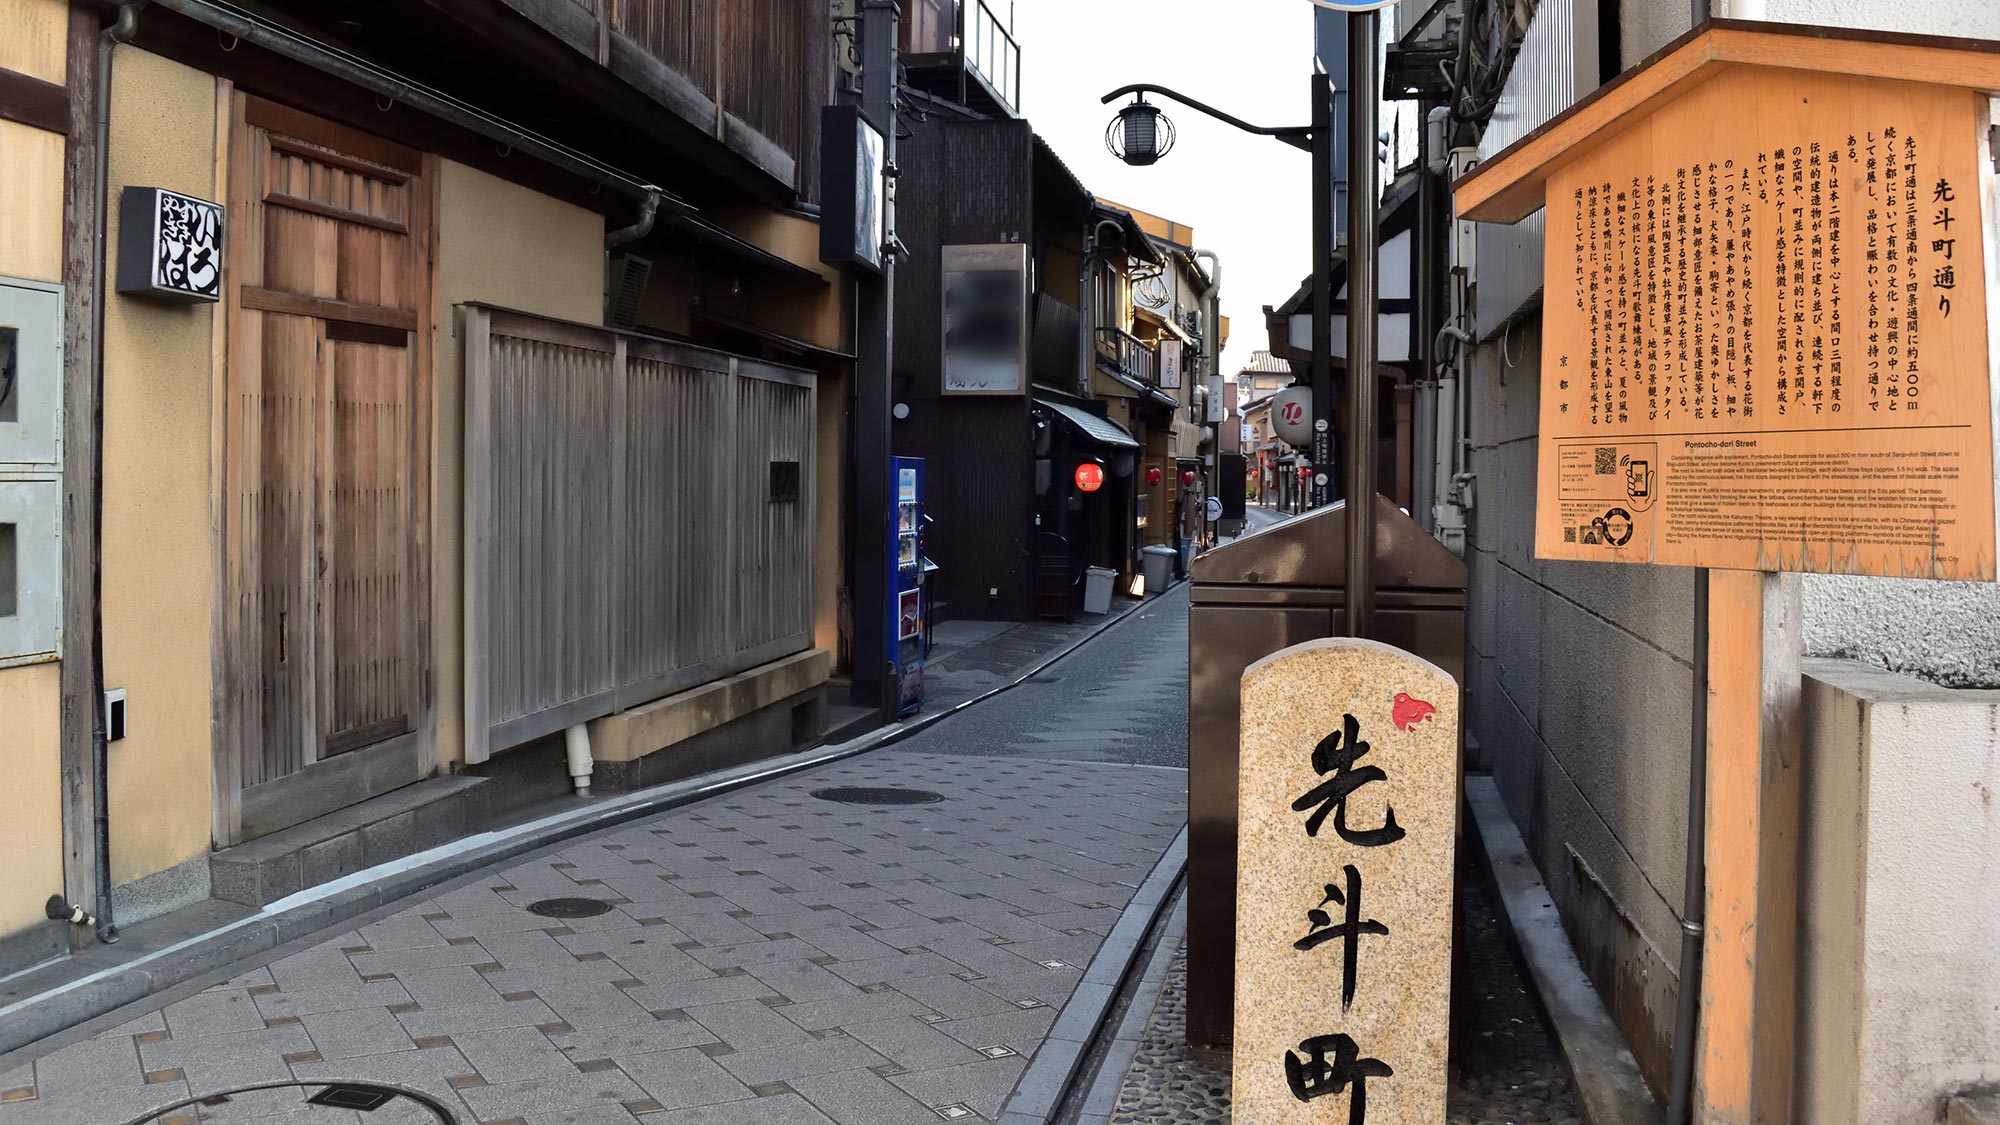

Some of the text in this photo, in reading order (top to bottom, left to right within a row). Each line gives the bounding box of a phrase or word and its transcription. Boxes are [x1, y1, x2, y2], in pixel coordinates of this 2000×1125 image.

[1757, 152, 1769, 204] れている。
[1846, 134, 1859, 164] ある。
[1931, 177, 1957, 319] 先斗町通り
[1559, 355, 1569, 414] 京都市
[1285, 713, 1407, 1125] 先斗町
